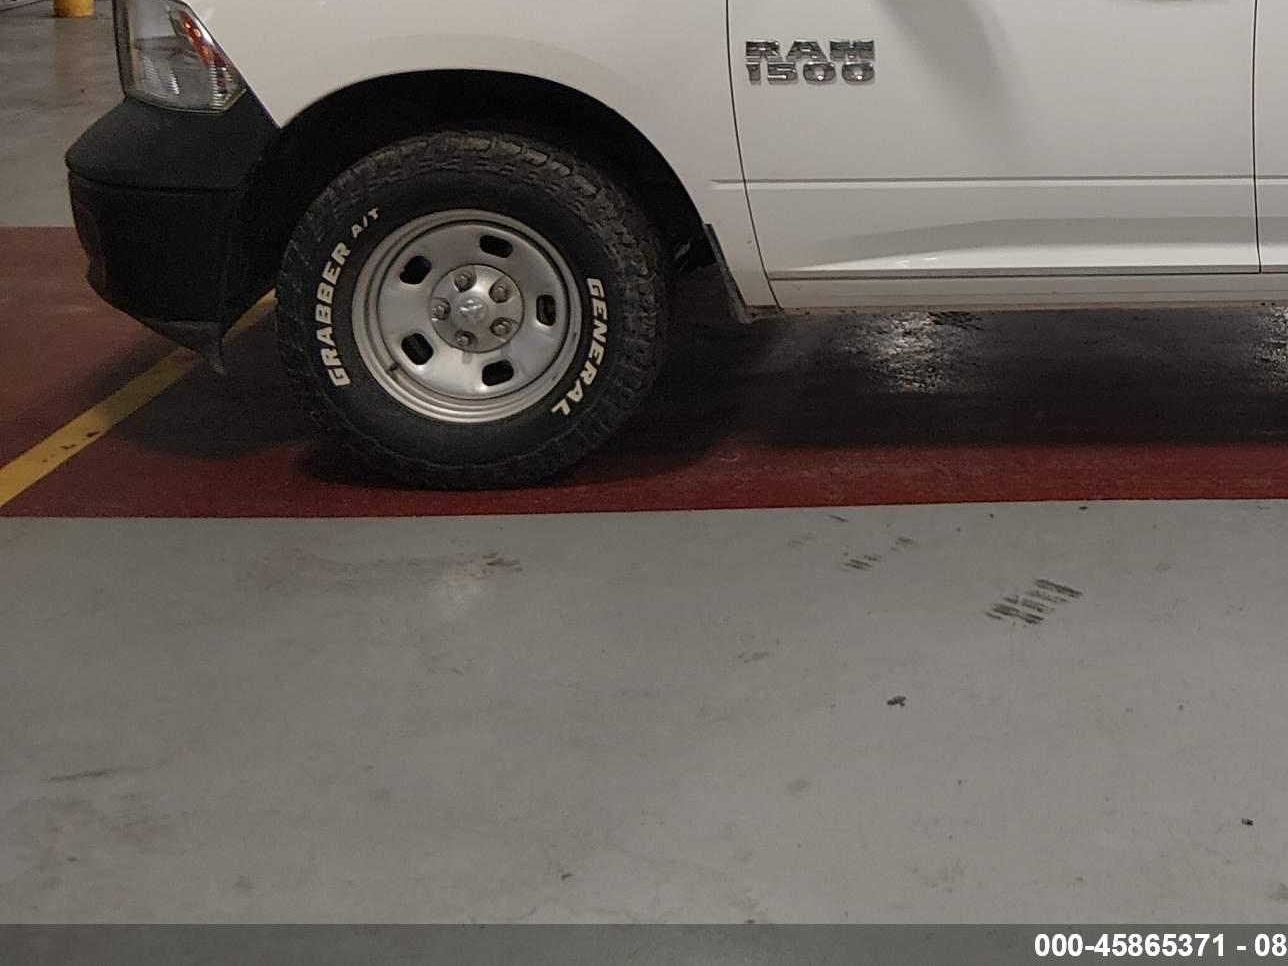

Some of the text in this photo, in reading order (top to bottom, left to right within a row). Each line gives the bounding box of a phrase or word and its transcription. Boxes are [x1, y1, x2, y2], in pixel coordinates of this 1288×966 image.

[744, 40, 875, 62] RAM
[745, 62, 875, 84] 1500
[314, 207, 380, 386] GRABBER A/T
[550, 277, 609, 416] GENERAL
